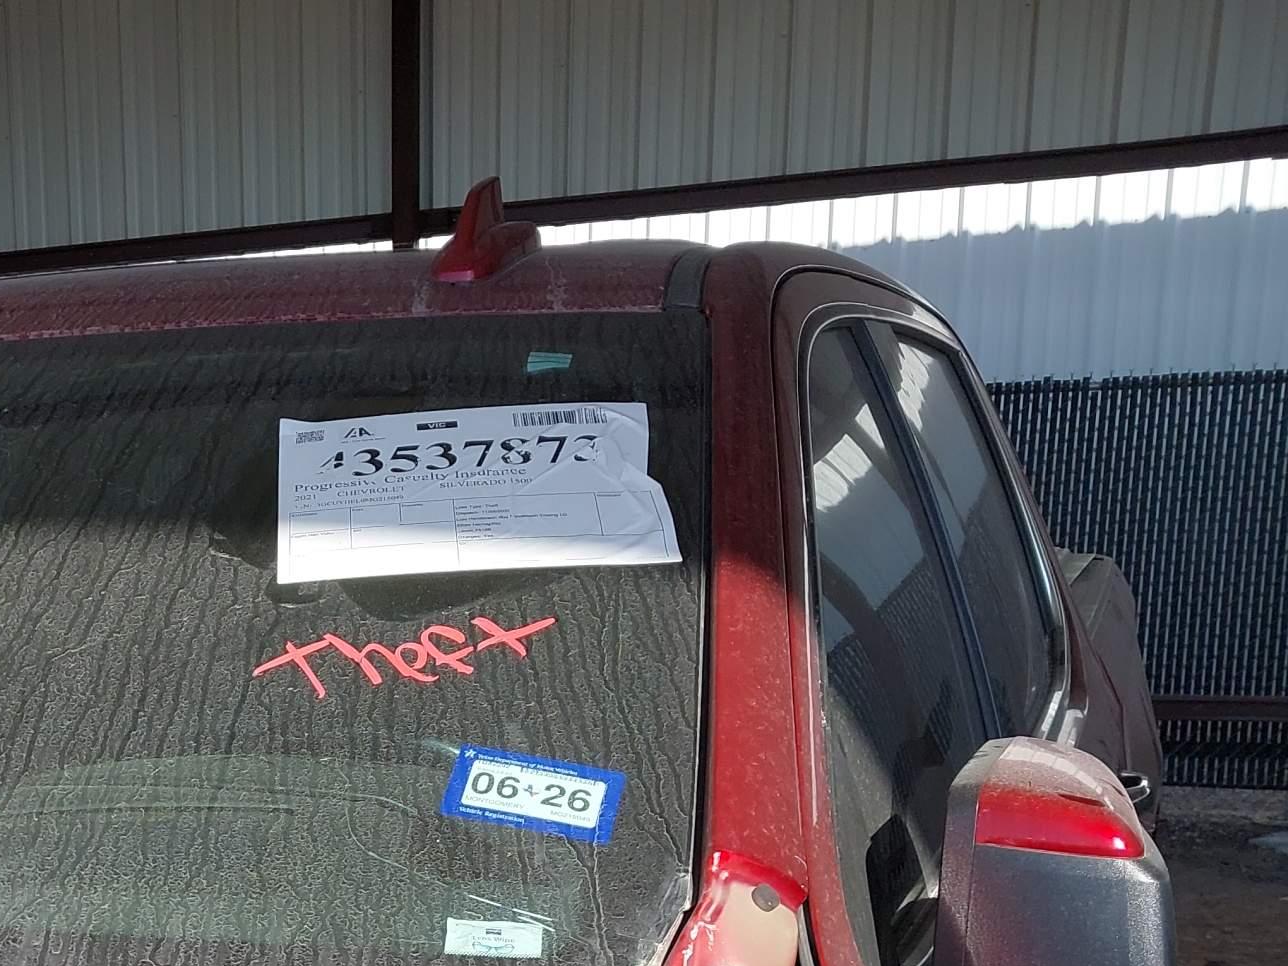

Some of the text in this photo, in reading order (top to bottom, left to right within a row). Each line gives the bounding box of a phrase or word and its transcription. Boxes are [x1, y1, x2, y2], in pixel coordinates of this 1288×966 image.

[427, 421, 447, 429] VIC
[316, 433, 598, 476] 43537873
[295, 476, 532, 502] 2021 CHEVROLET SILVERADO 1500
[384, 470, 449, 486] Casualty
[471, 771, 521, 799] 06
[540, 783, 592, 812] 26
